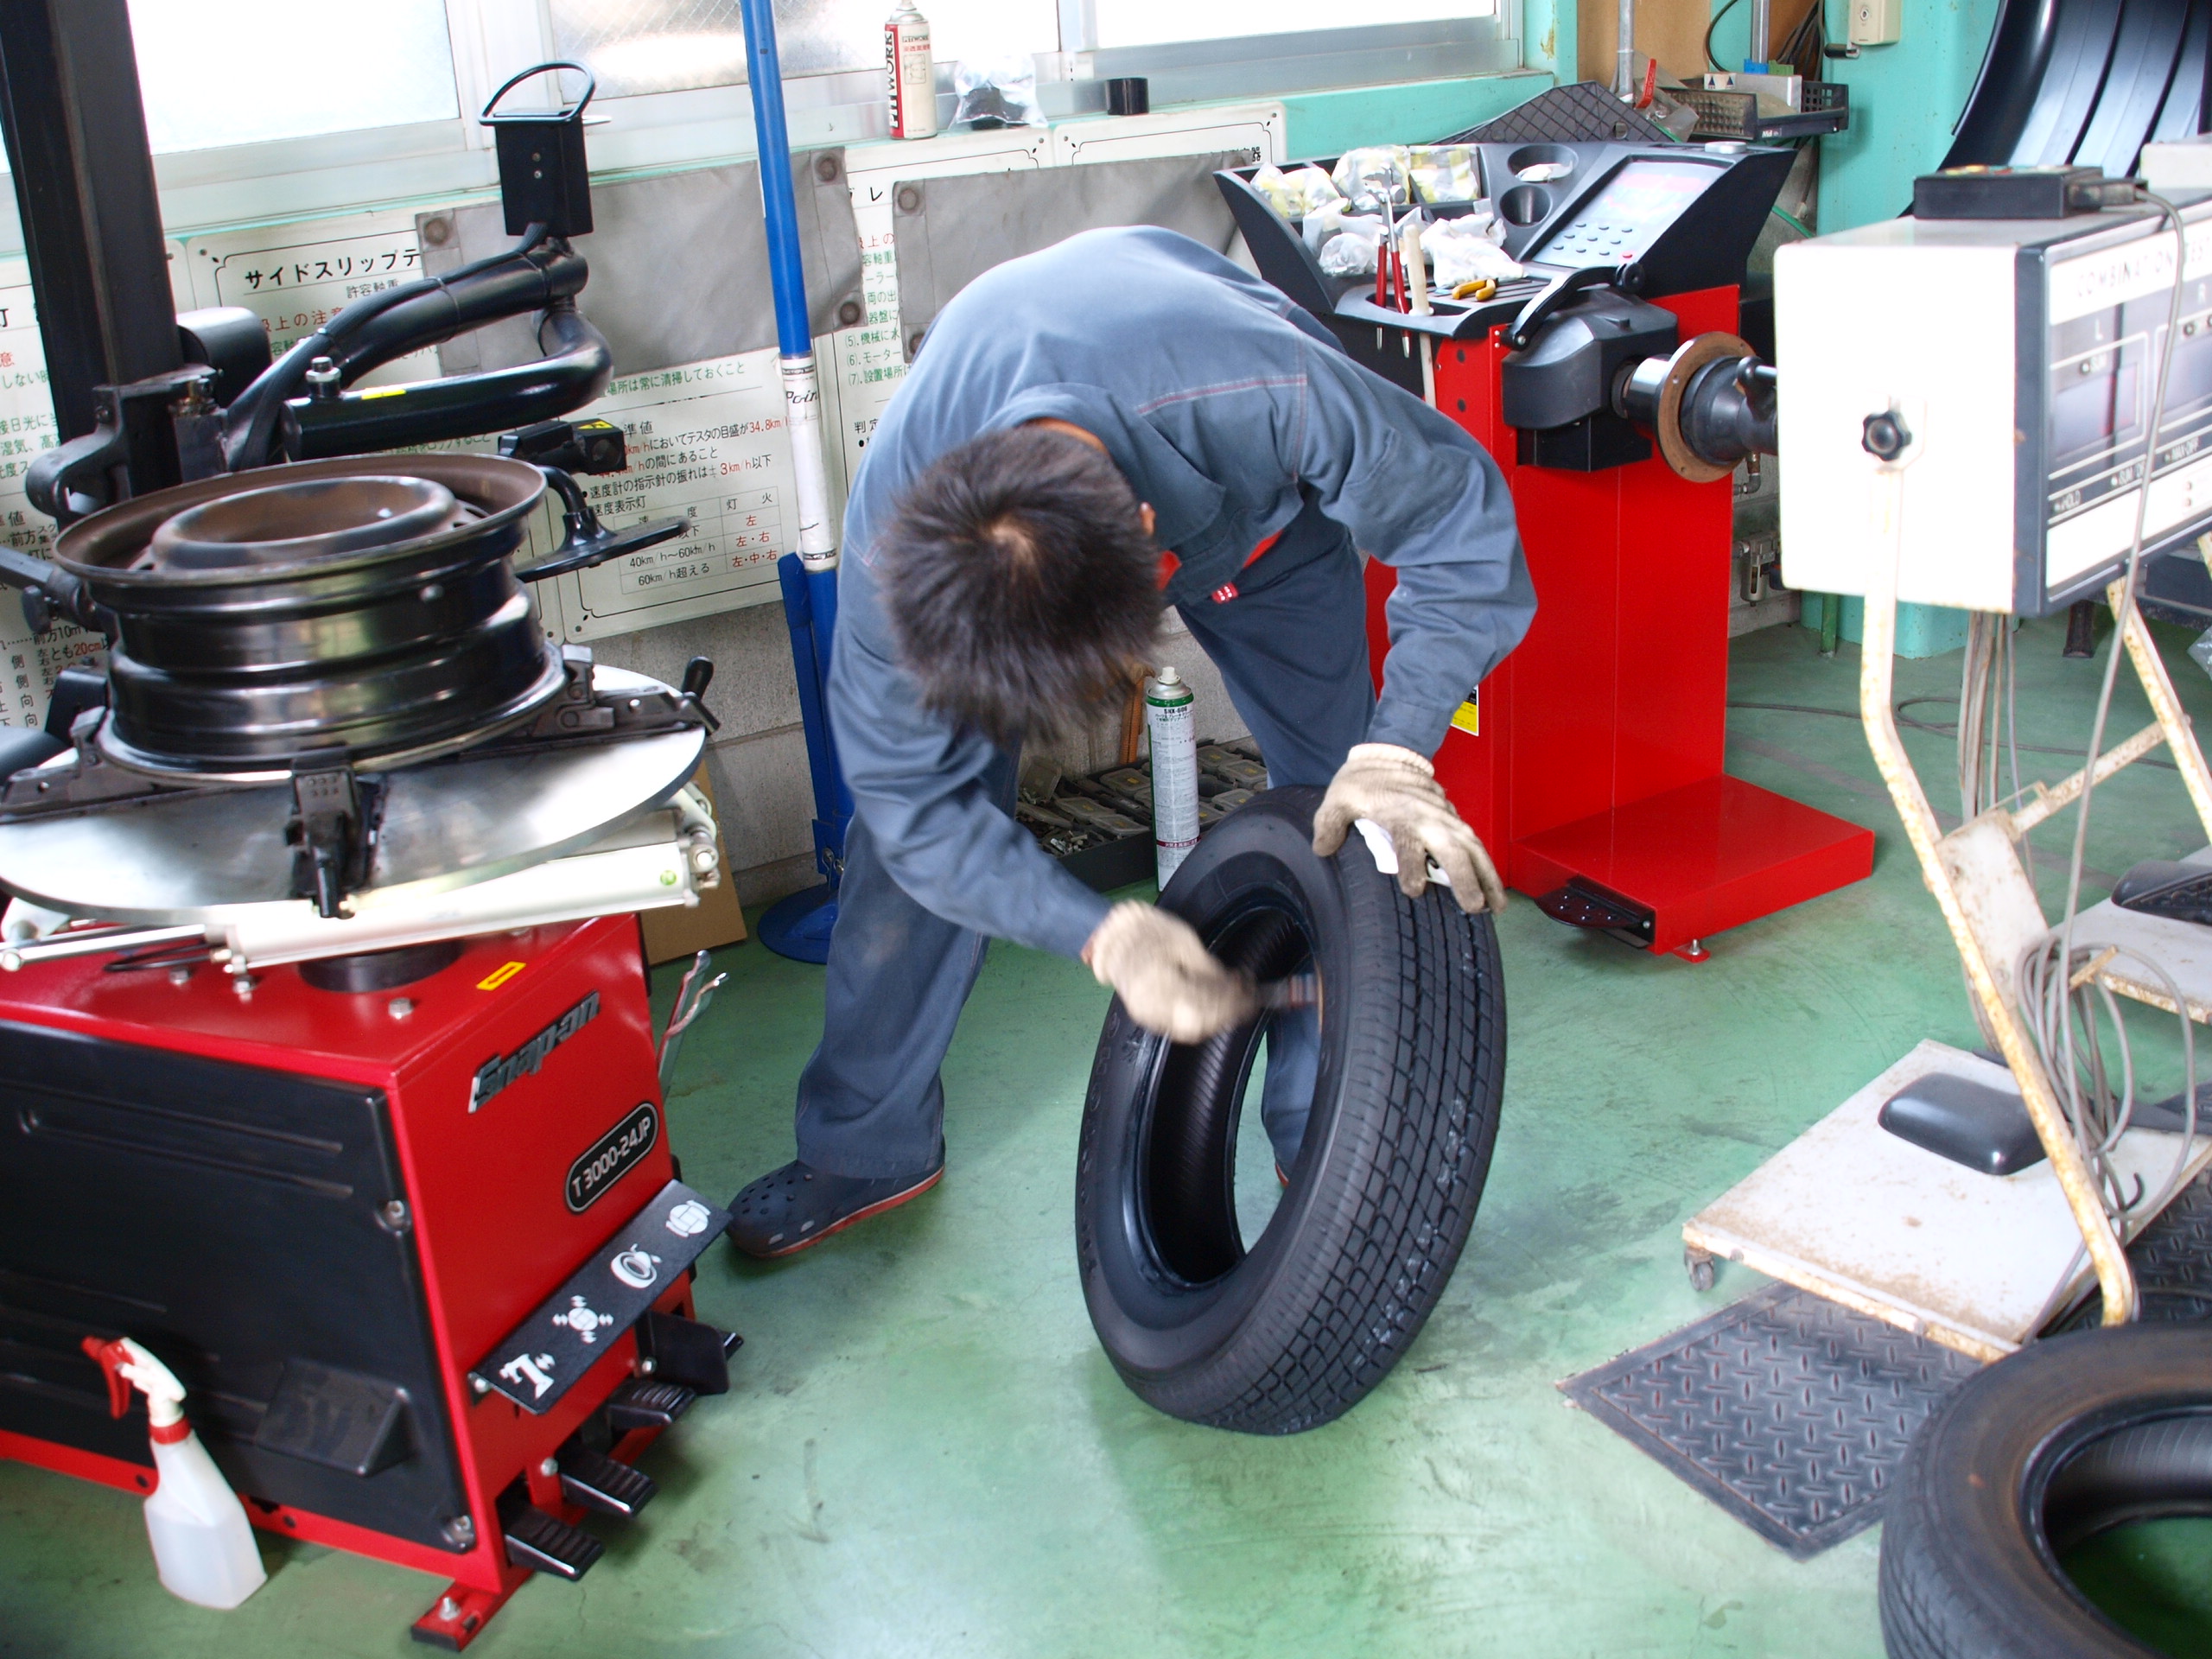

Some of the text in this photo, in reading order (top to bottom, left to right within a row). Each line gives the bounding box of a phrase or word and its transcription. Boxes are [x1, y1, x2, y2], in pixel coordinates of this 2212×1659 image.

[885, 32, 899, 128] PITWORK
[245, 249, 421, 289] サイドスリップテ
[746, 515, 757, 527] 左
[572, 1116, 652, 1198] T 3000-24JP
